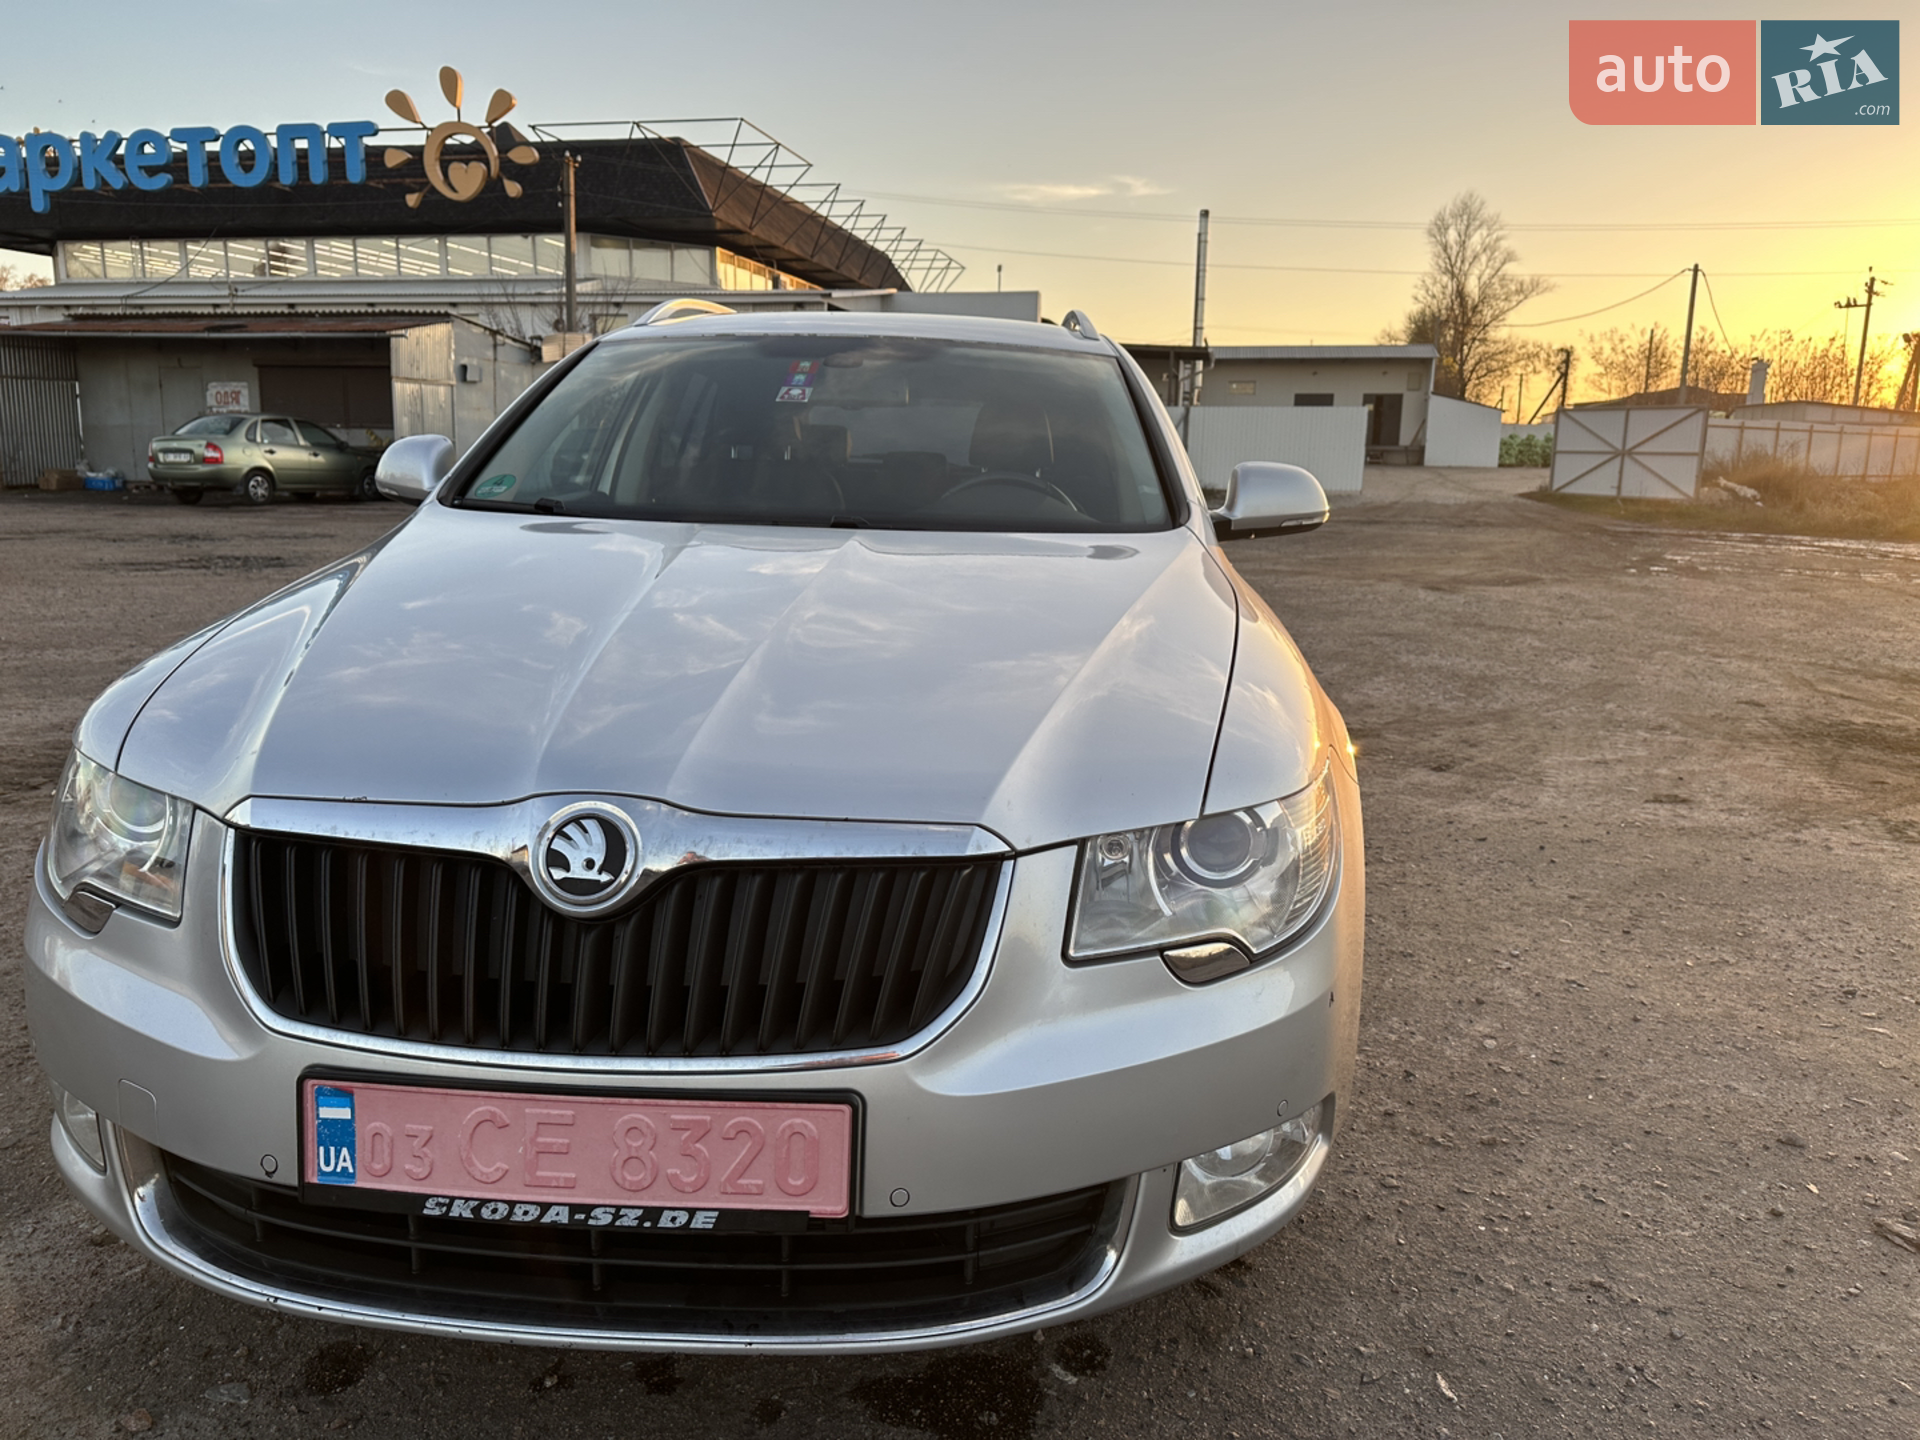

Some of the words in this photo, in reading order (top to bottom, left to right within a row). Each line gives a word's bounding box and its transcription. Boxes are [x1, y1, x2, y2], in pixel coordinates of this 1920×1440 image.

[319, 1146, 354, 1173] UA
[363, 1121, 434, 1180] 03
[459, 1105, 577, 1188] CE
[610, 1113, 819, 1196] 8320
[423, 1197, 719, 1229] SKODA-SZ.DE
